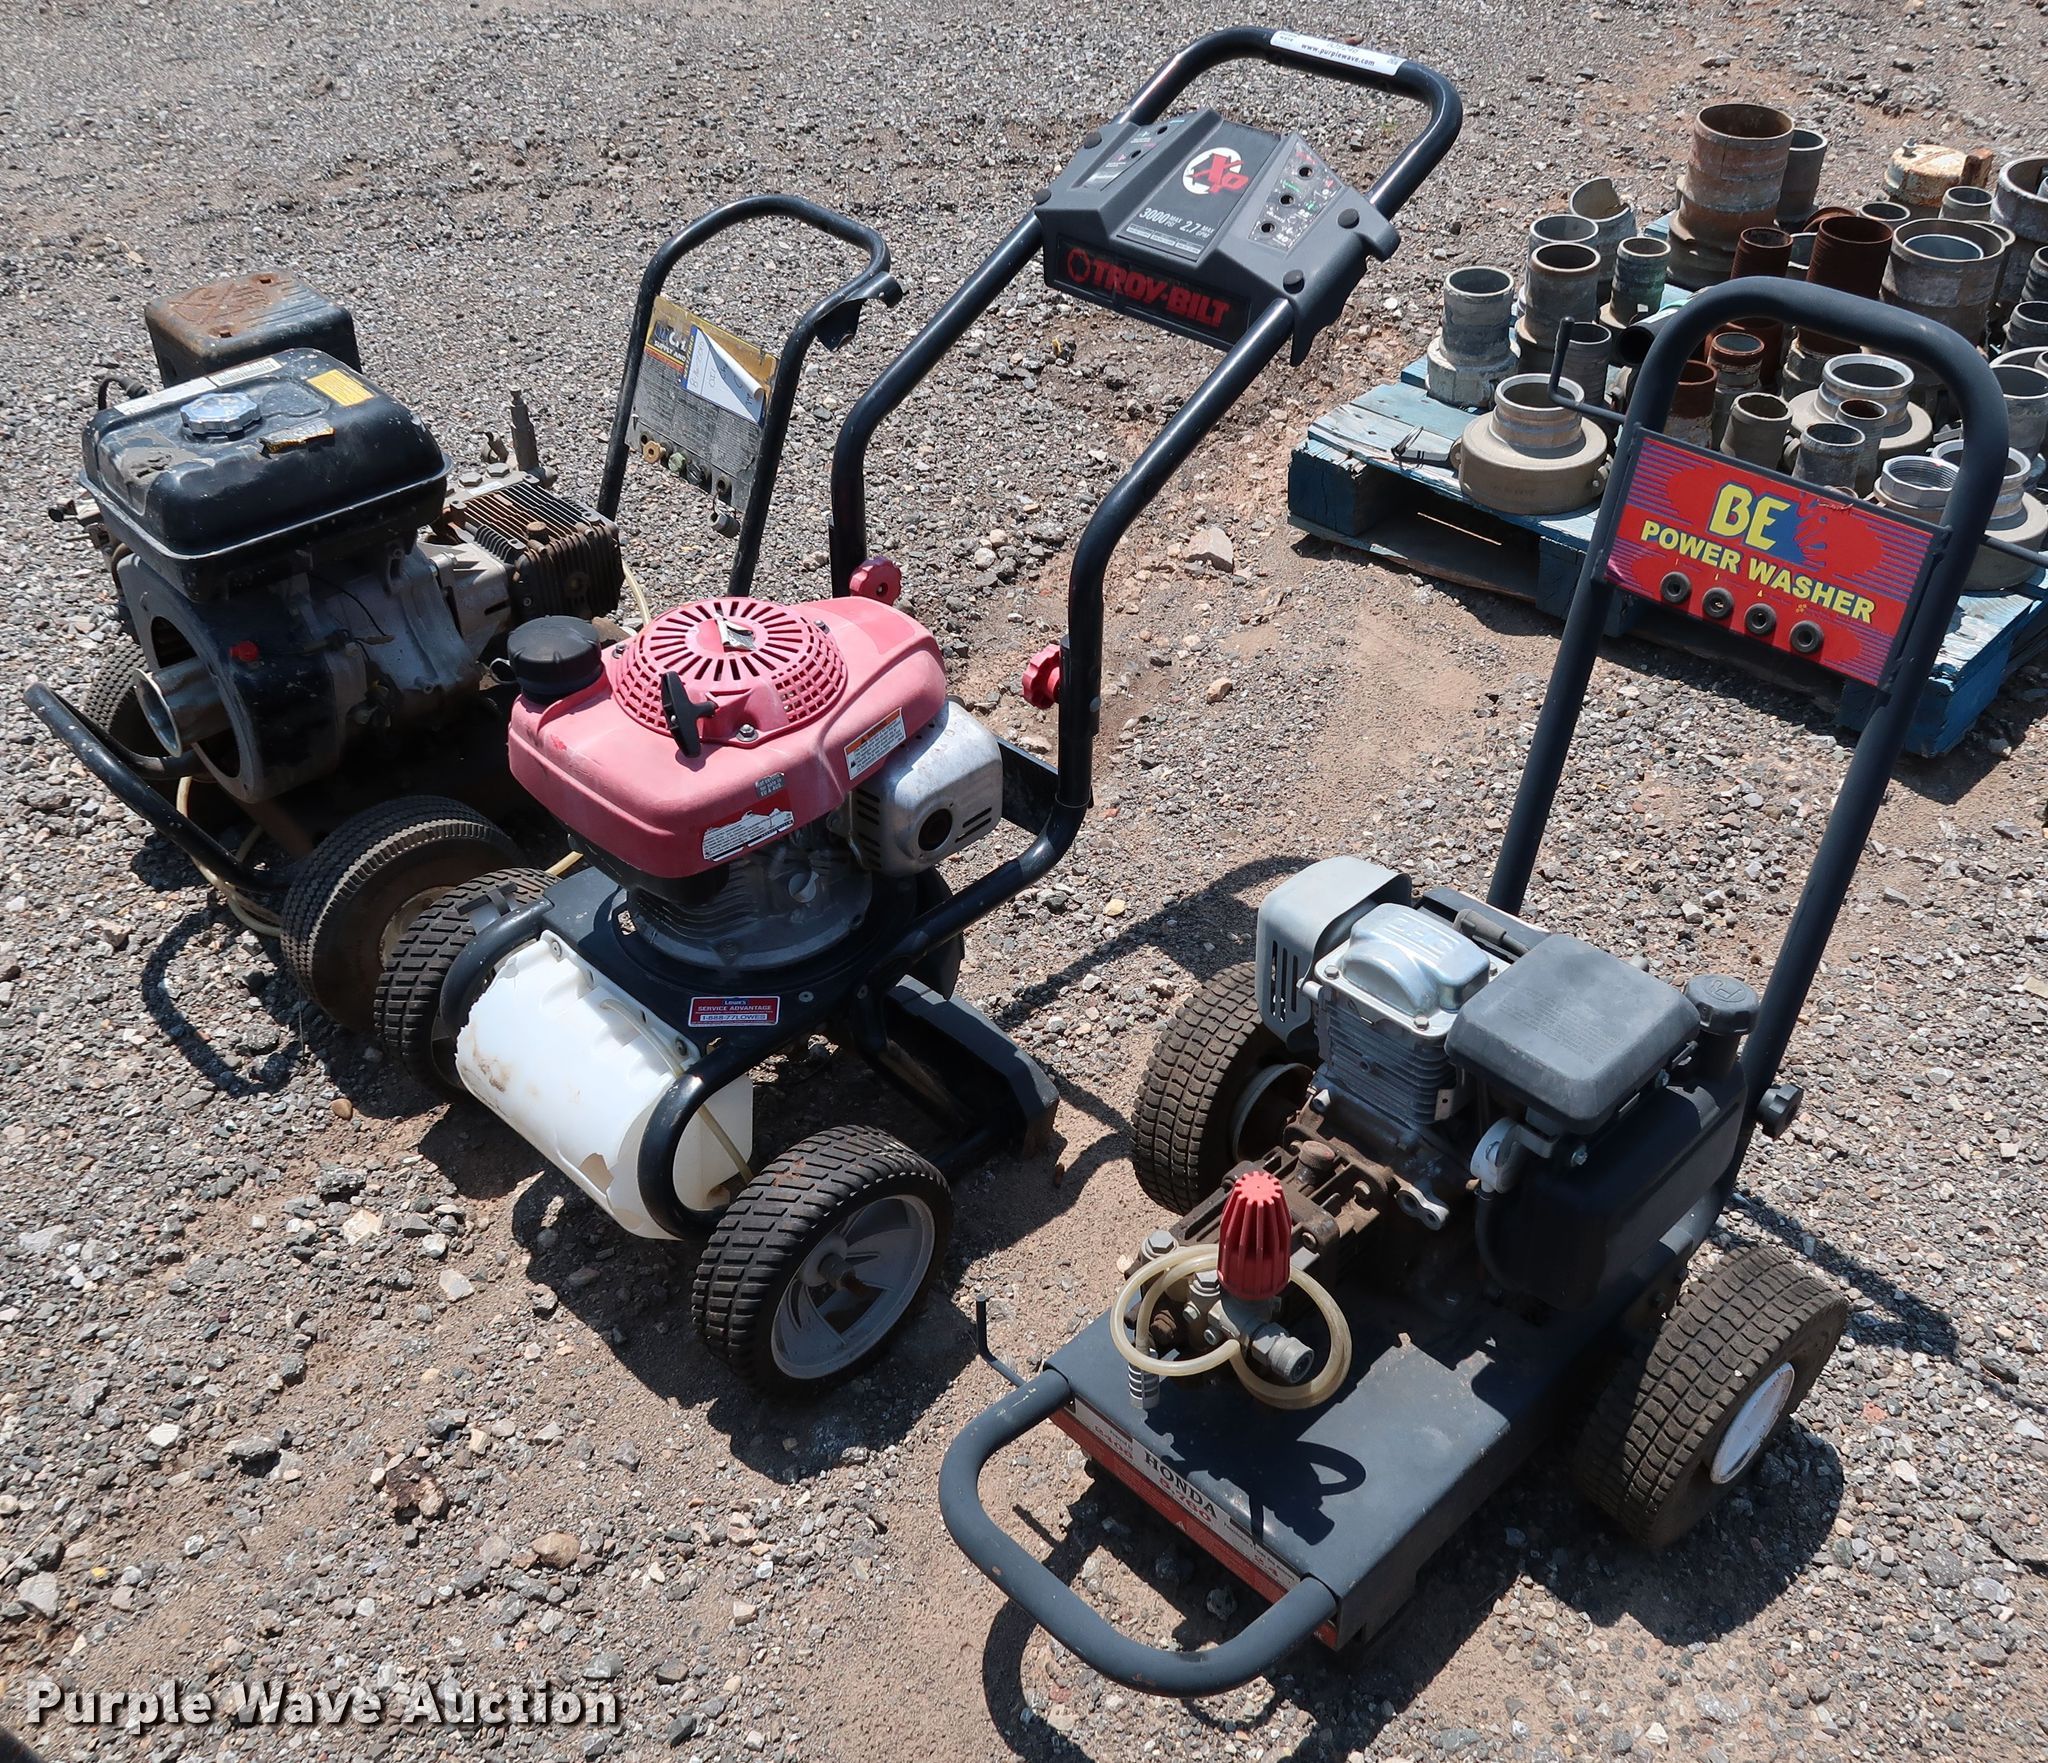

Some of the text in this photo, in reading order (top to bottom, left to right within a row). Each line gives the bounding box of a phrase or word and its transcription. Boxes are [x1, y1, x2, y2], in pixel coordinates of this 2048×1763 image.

[1301, 43, 1375, 67] www.purplewave.com
[1139, 207, 1170, 225] 3000
[1179, 220, 1201, 233] 2.7
[1092, 259, 1232, 329] TROY-BILT
[1709, 482, 1791, 551] BE
[1640, 519, 1876, 624] POWER WASHER
[1144, 1451, 1219, 1518] HONDA
